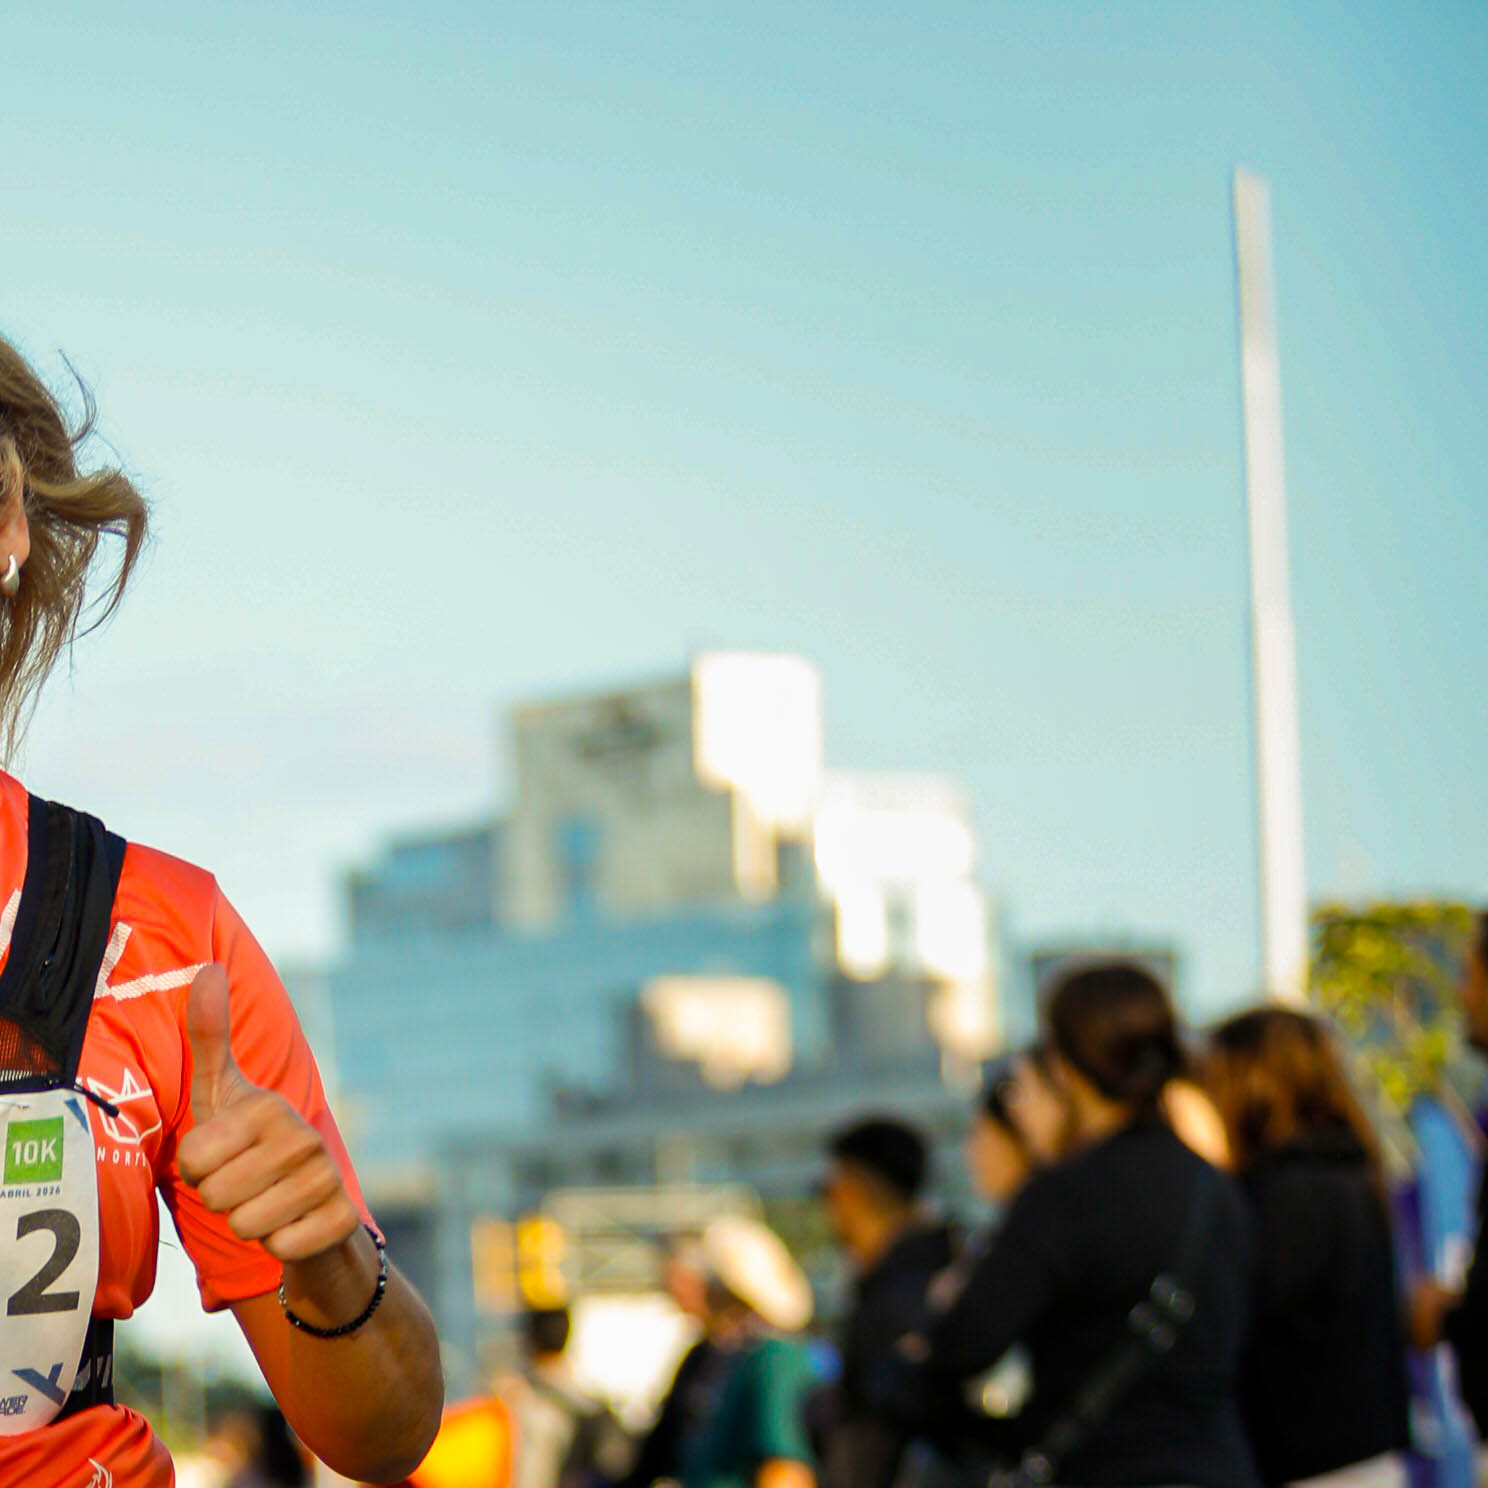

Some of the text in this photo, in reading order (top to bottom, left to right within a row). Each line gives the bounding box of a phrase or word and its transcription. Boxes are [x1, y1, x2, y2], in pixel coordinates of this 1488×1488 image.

[11, 1138, 58, 1165] 10K
[0, 1187, 31, 1199] ABRIL
[36, 1185, 62, 1197] 2026
